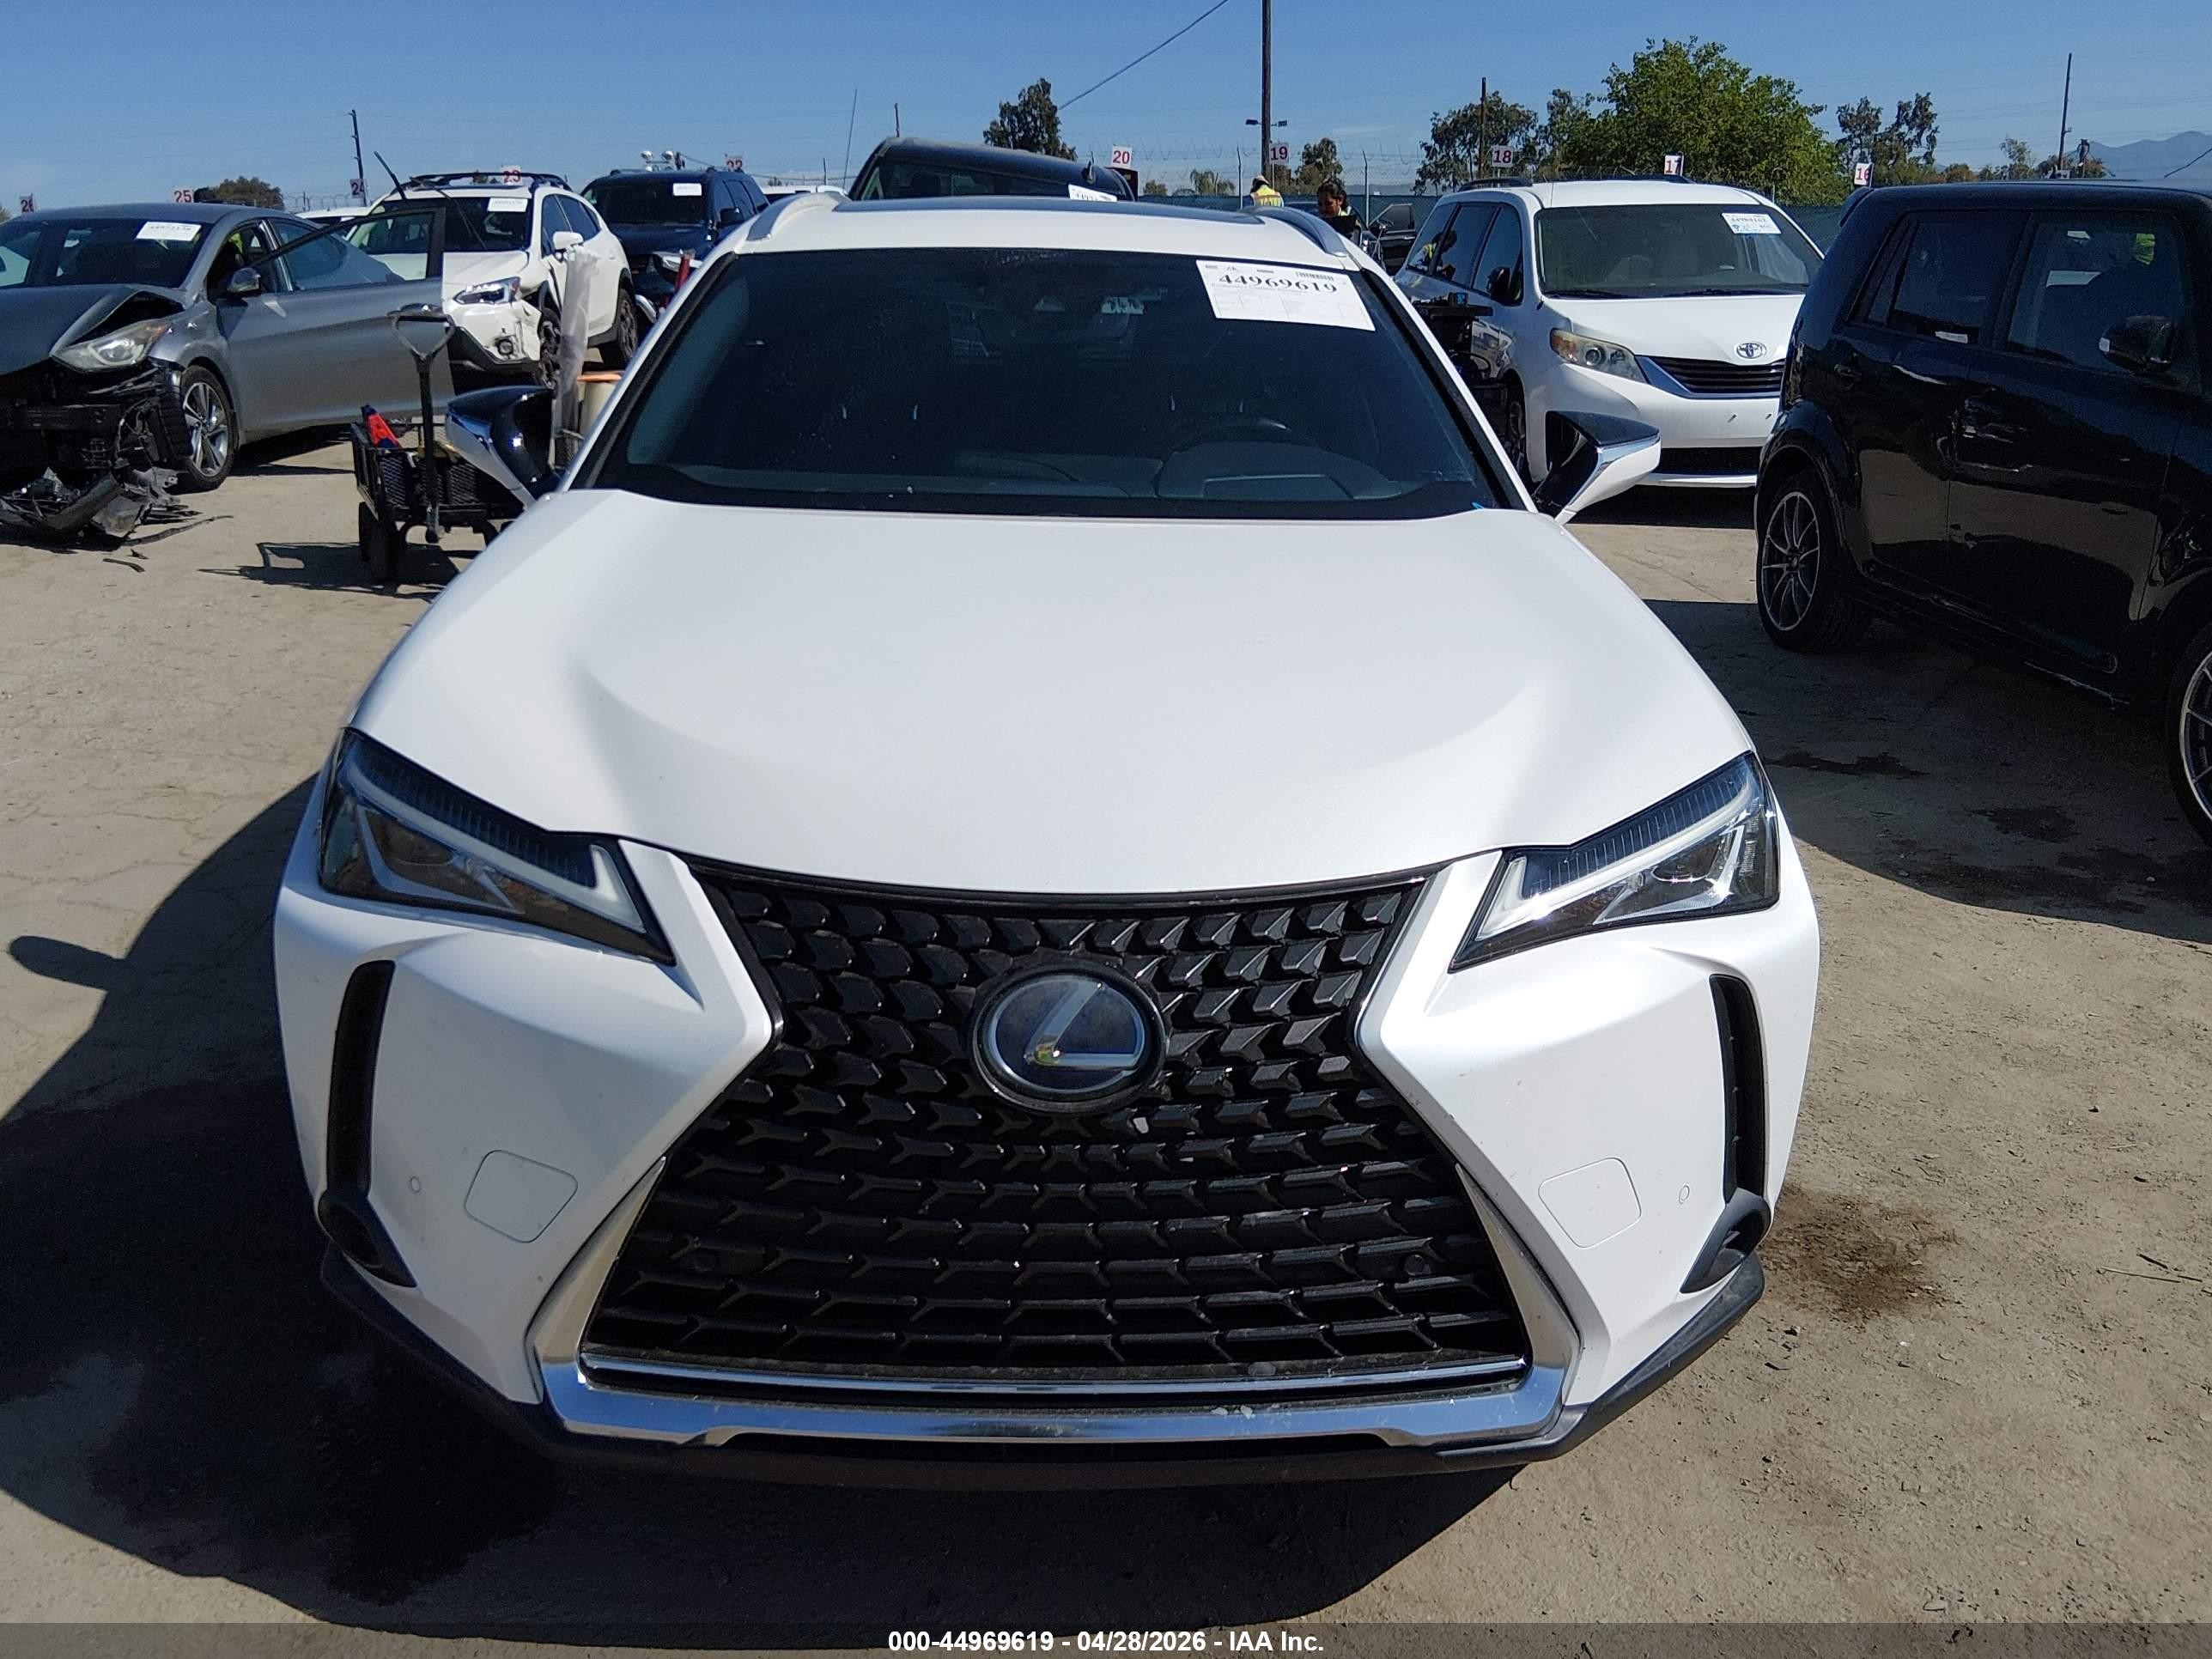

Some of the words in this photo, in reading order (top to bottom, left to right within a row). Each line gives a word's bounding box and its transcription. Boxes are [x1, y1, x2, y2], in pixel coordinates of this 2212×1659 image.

[1112, 150, 1130, 164] 20
[1270, 146, 1288, 161] 19
[1493, 149, 1511, 163] 18
[173, 190, 192, 203] 25
[1218, 274, 1338, 293] 44969619
